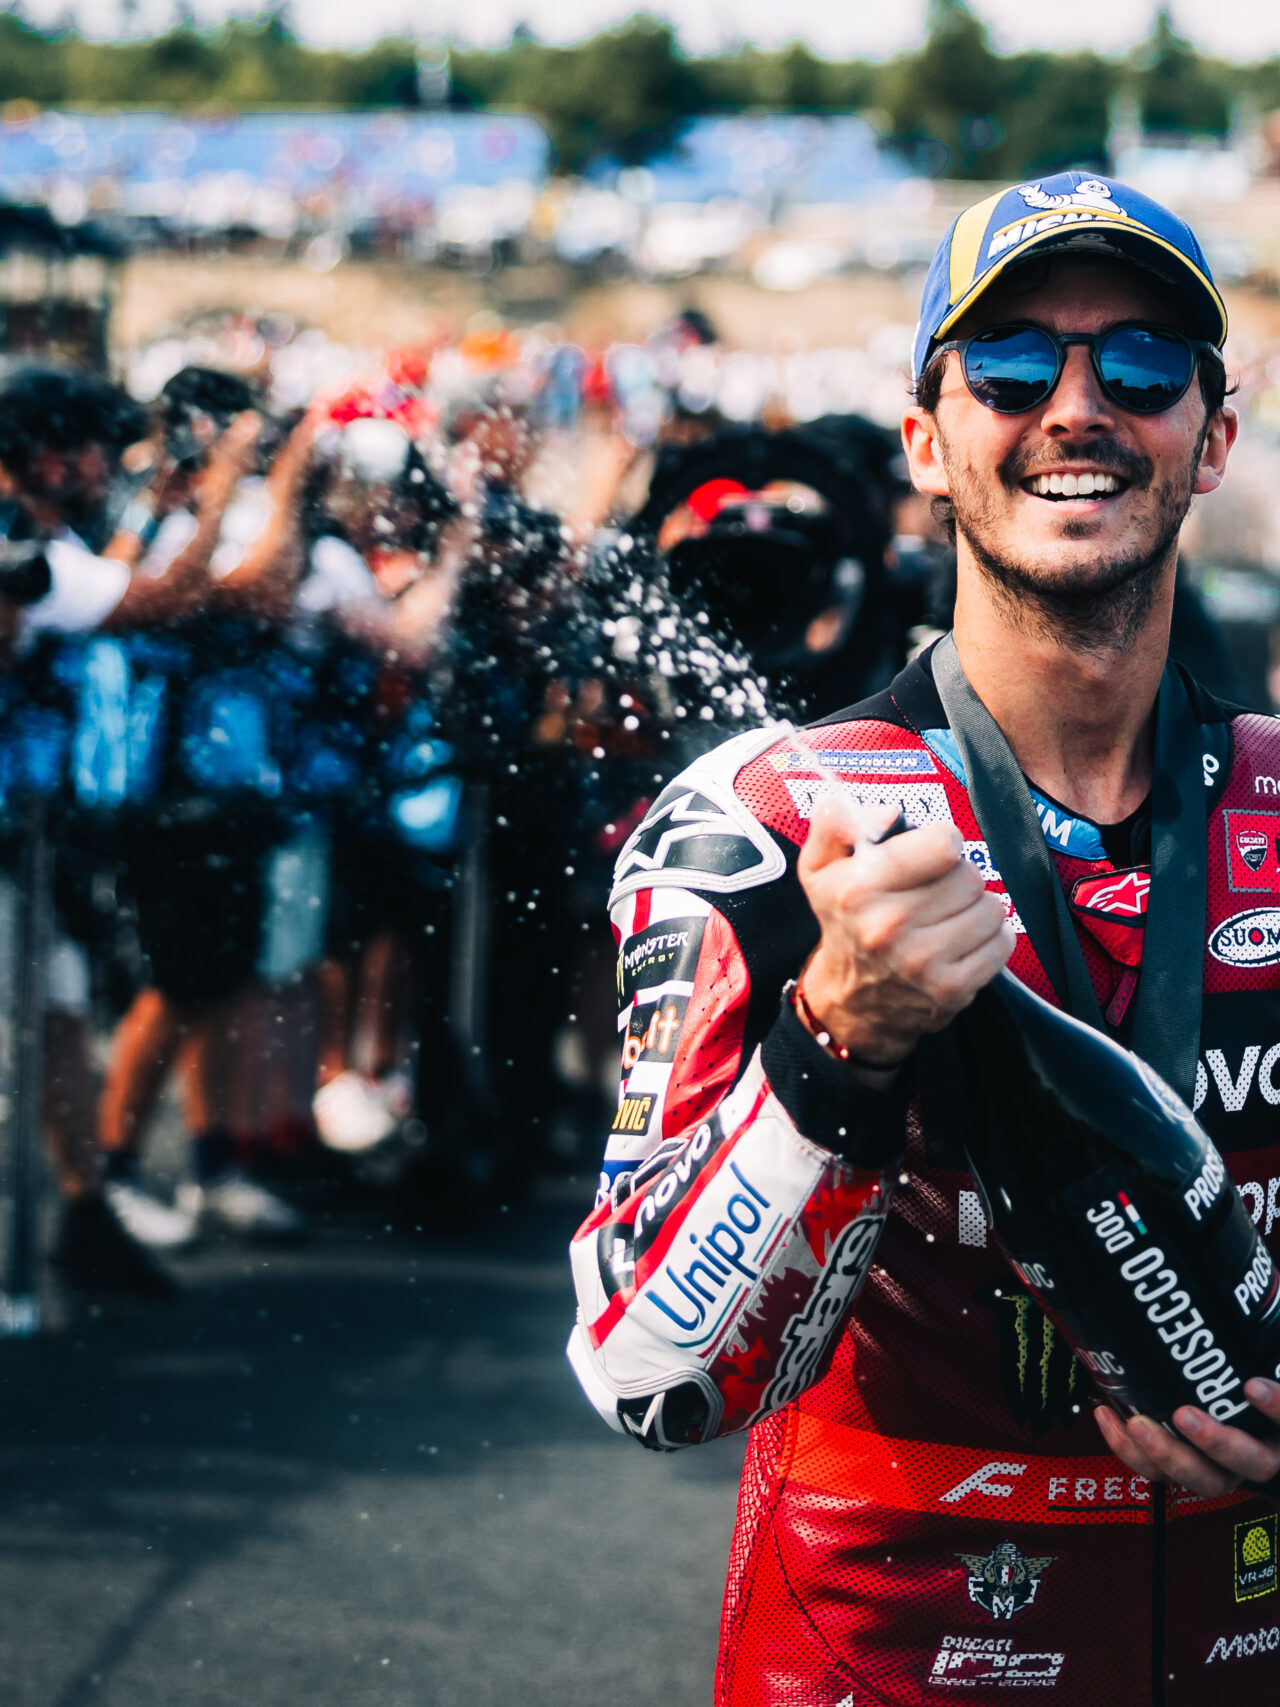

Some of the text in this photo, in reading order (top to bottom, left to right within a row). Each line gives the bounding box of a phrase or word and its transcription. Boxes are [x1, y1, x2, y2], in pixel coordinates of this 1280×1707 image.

[624, 931, 689, 970] MONSTER
[645, 1161, 771, 1332] Unipol
[1086, 1200, 1250, 1421] PROSECCO DOC
[941, 1635, 1013, 1651] DUCATI
